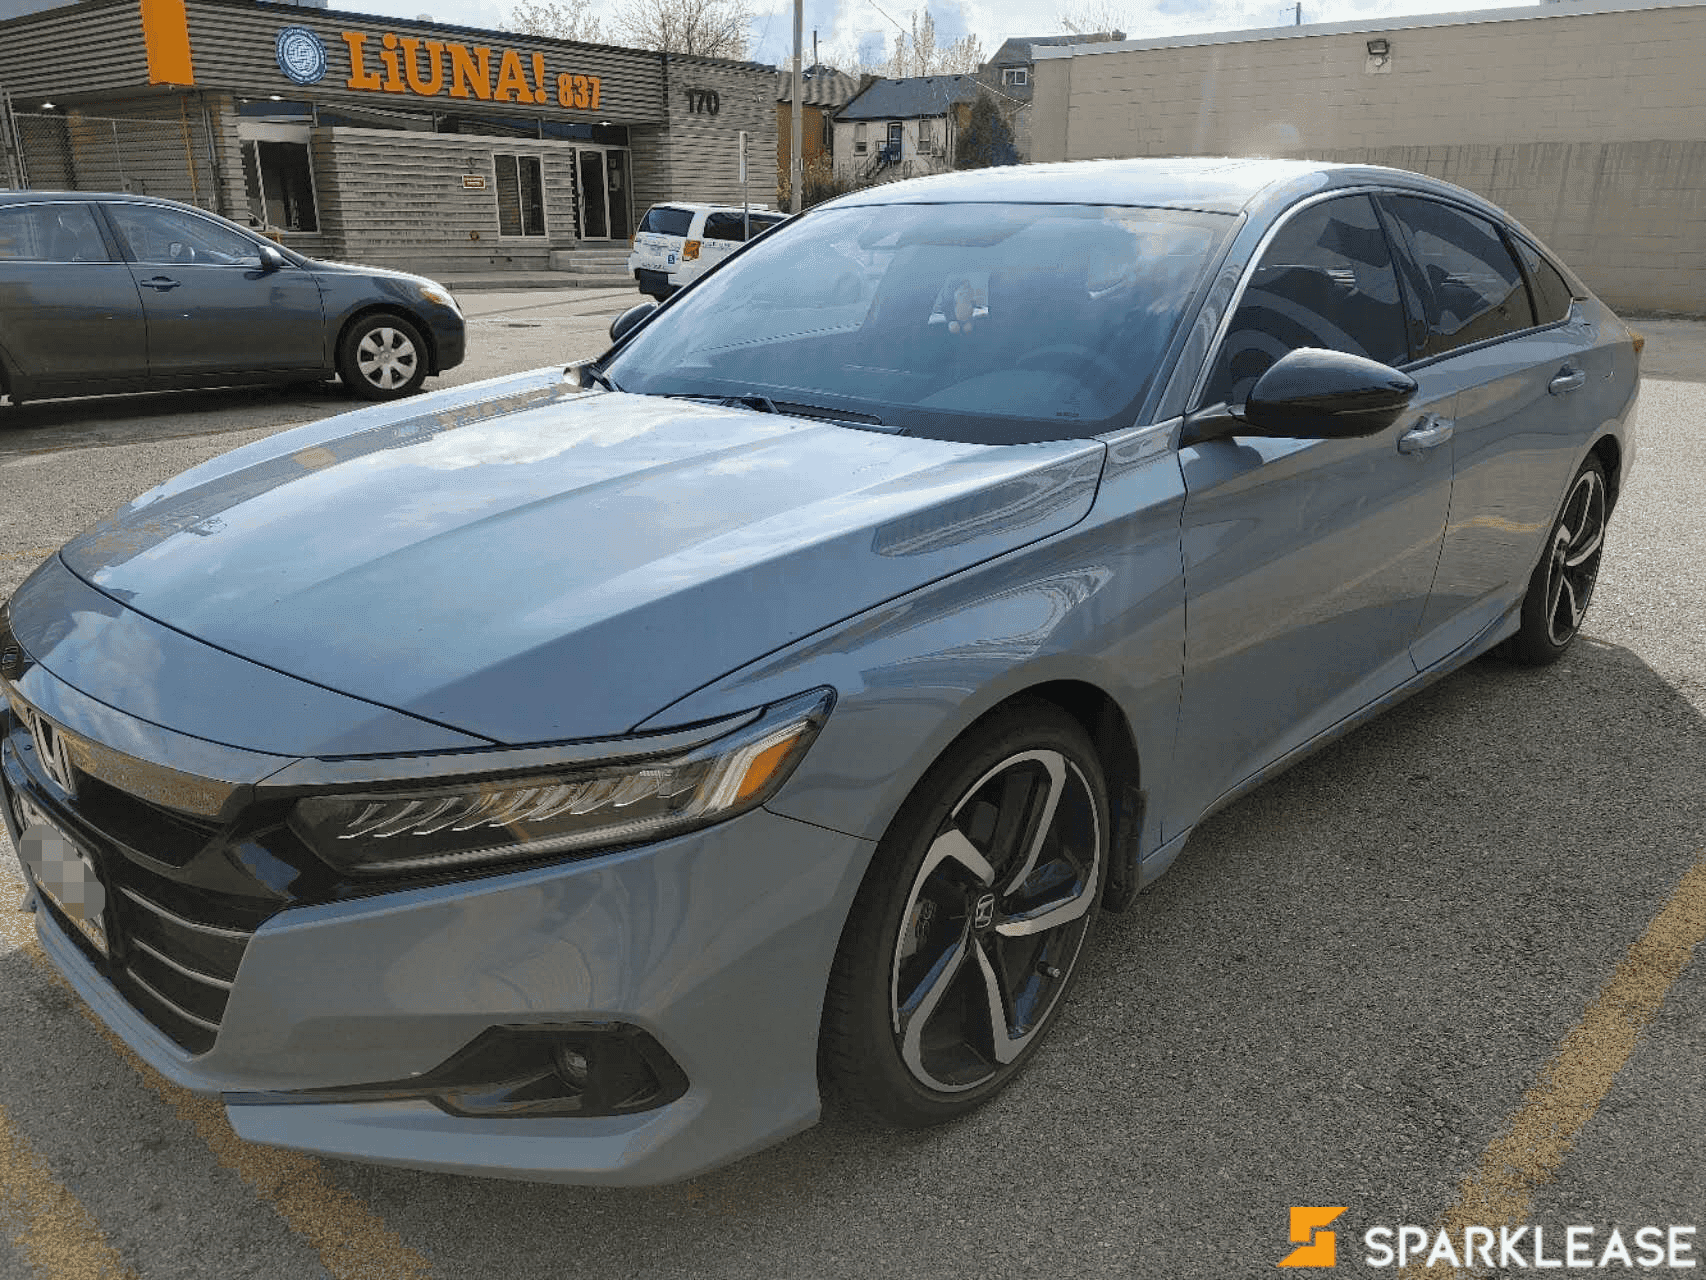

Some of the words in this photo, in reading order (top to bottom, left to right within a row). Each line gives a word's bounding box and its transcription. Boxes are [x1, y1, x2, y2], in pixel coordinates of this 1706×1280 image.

[341, 31, 548, 104] LiUNA!
[556, 72, 601, 110] 837
[685, 88, 720, 116] 170
